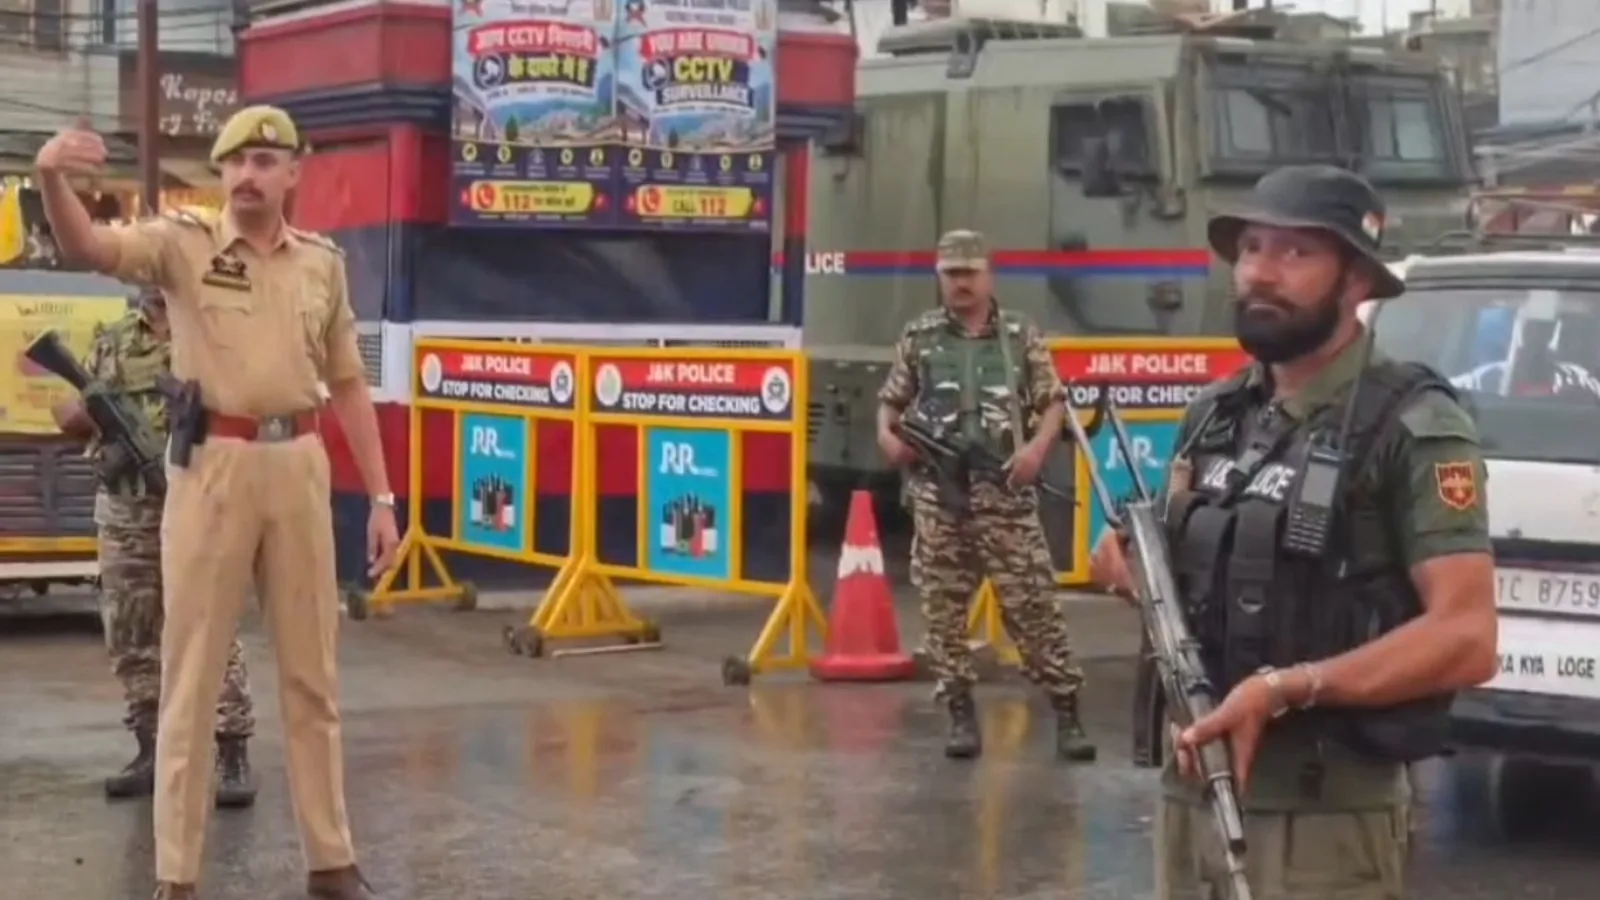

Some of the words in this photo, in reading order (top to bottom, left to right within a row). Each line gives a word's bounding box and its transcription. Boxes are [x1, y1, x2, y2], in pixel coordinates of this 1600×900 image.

[674, 56, 732, 82] CCTV
[503, 194, 530, 210] 112
[700, 198, 727, 214] 112
[486, 356, 531, 375] POLICE
[677, 364, 735, 383] POLICE
[1085, 355, 1126, 374] J&K
[1131, 355, 1208, 374] POLICE
[442, 380, 469, 397] STOP
[470, 383, 493, 399] FOR
[494, 384, 550, 403] CHECKING
[623, 392, 656, 409] STOP
[658, 396, 686, 410] FOR
[688, 397, 761, 414] CHECKING
[1538, 578, 1599, 608] 8759
[1520, 654, 1545, 675] KYA
[1557, 655, 1596, 678] LOGE
